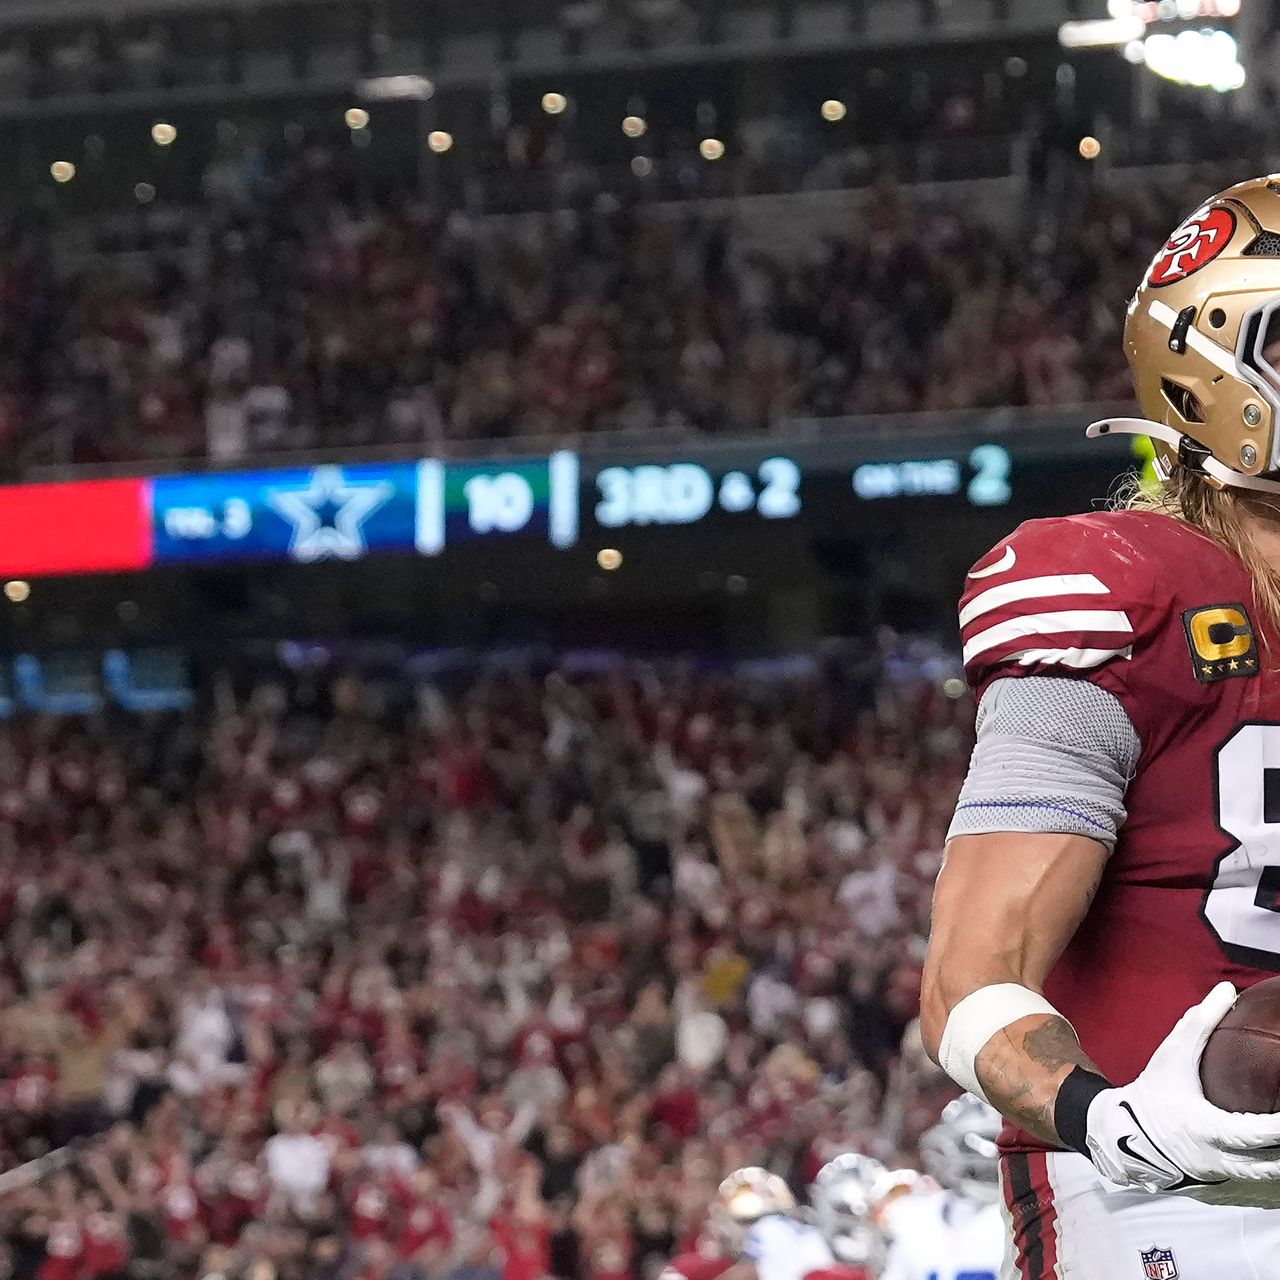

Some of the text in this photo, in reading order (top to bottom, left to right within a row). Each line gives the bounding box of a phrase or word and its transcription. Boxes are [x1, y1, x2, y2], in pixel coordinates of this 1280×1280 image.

[463, 472, 535, 534] 10
[594, 462, 714, 528] 3RD
[757, 456, 802, 519] 2
[967, 443, 1012, 506] 2
[1190, 608, 1254, 662] C
[1147, 1262, 1174, 1279] NFL
